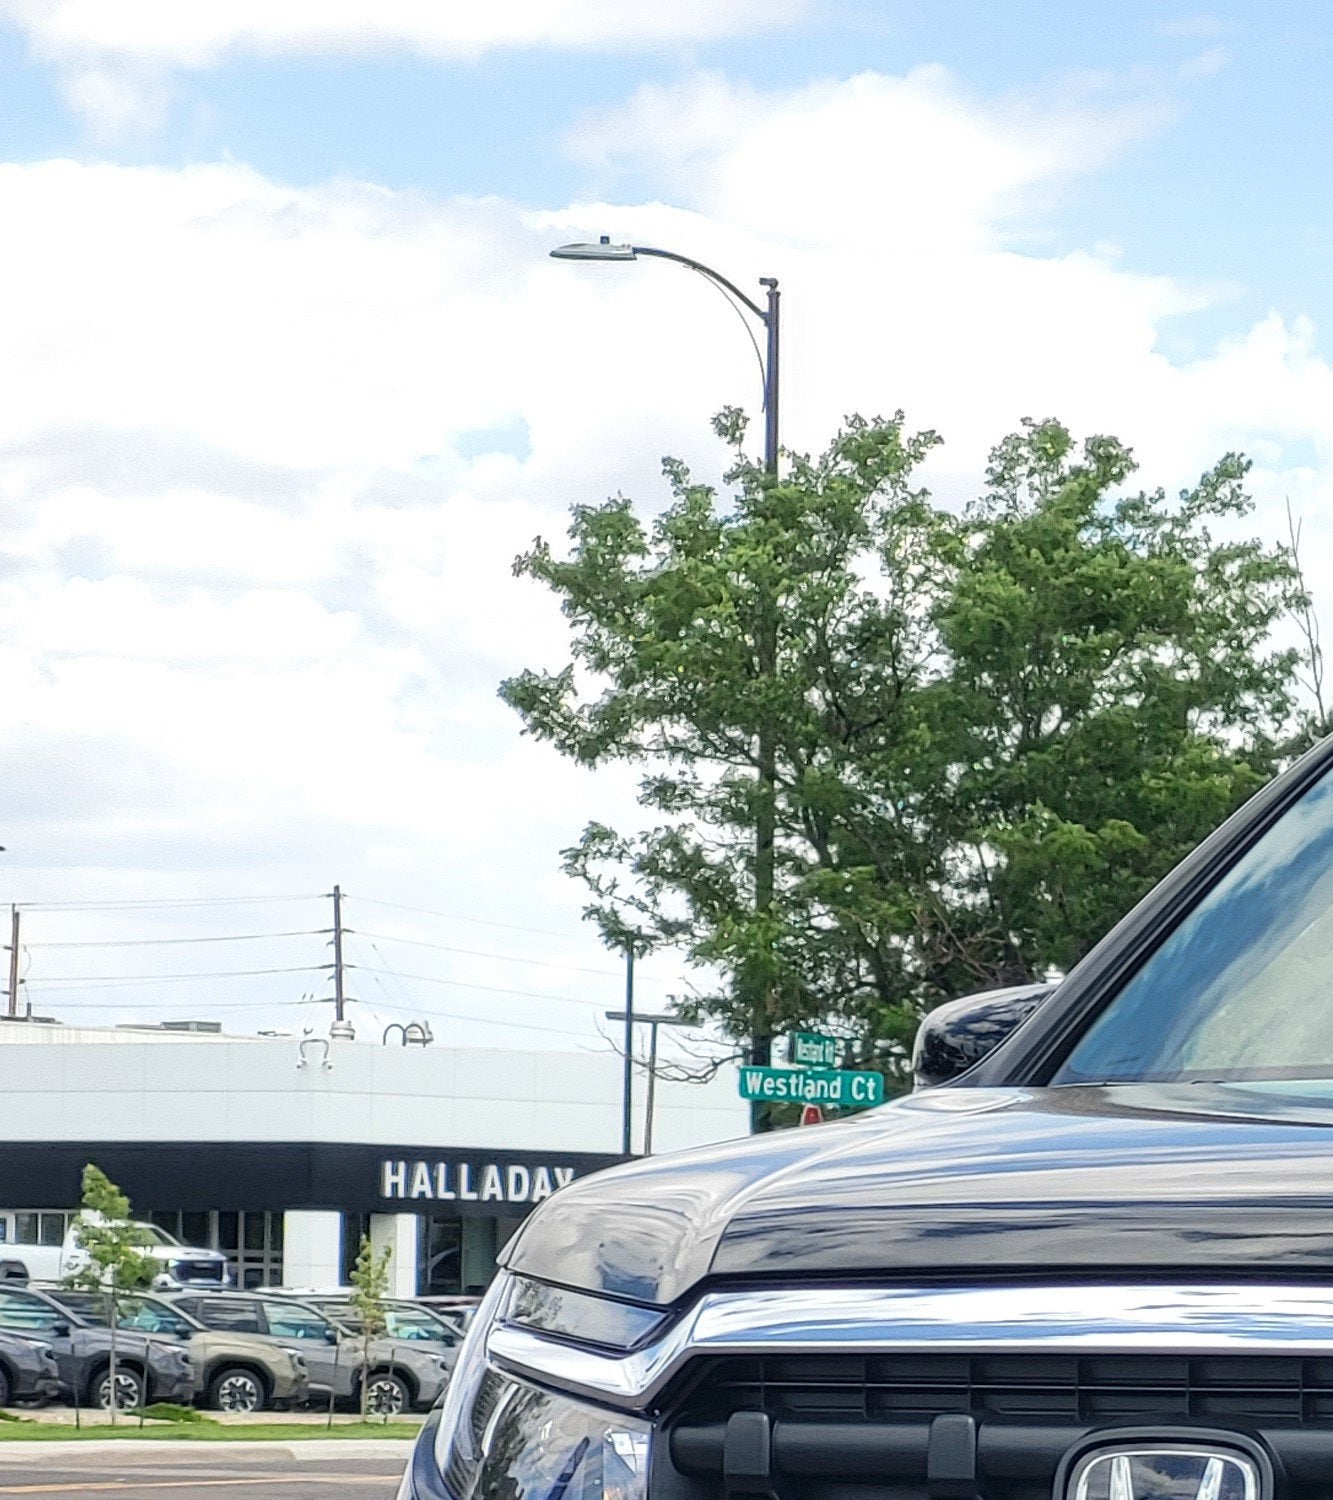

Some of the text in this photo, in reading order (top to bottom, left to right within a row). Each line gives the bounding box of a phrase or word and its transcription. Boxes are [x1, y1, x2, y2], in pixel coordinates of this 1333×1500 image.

[746, 1071, 877, 1101] Westland Ct
[381, 1159, 575, 1203] HALLADAY
